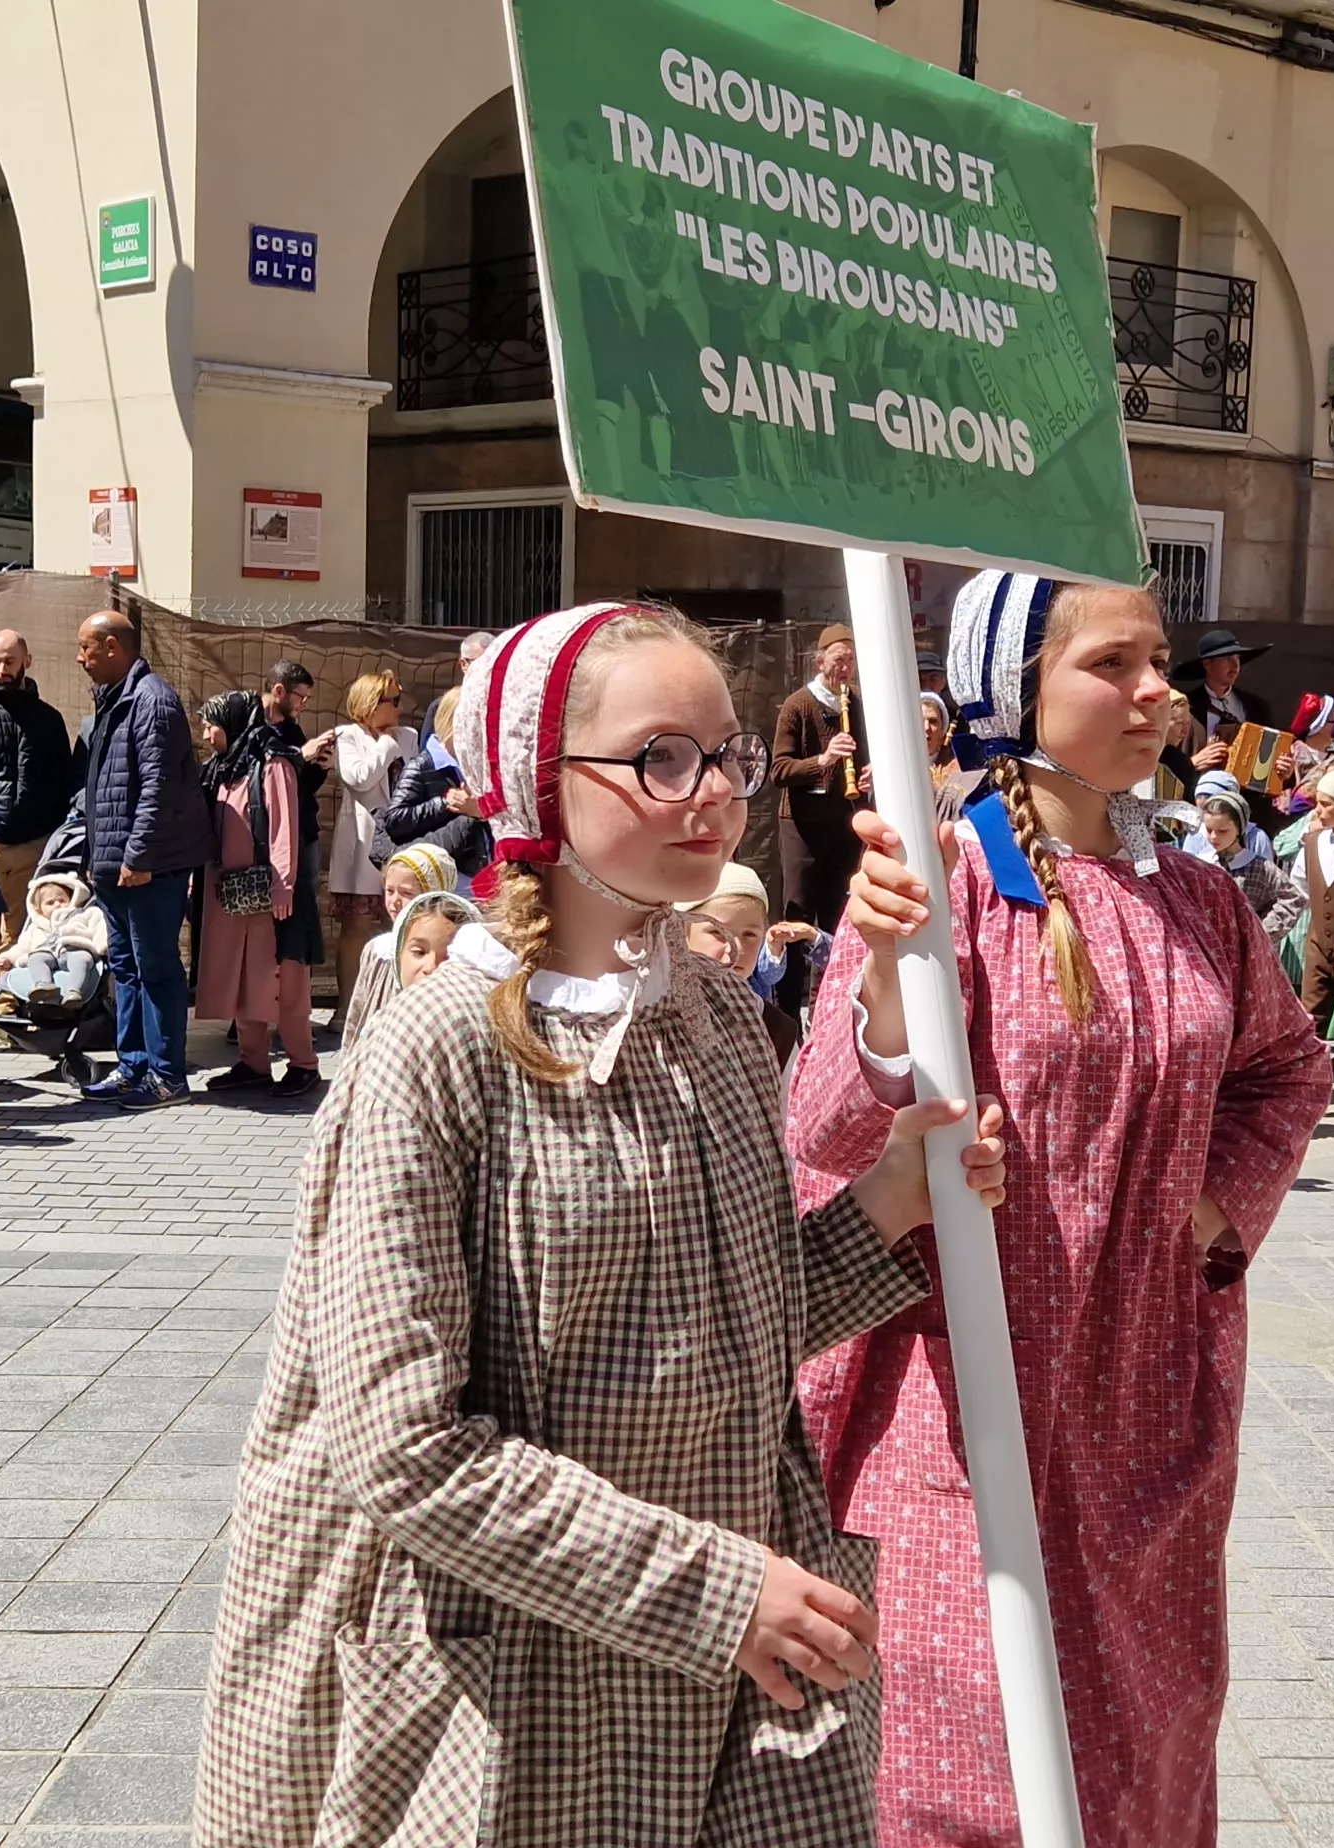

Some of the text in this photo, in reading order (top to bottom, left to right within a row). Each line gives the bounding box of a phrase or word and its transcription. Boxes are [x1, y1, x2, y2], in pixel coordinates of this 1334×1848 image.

[659, 47, 996, 208] GROUPE D'ARTS ET
[256, 234, 313, 257] COSO
[600, 103, 1058, 293] TRADITIONS POPULAIRES
[255, 260, 312, 283] ALTO
[674, 209, 1019, 348] "LES BIROUSSANS"
[699, 346, 837, 436] SAINT
